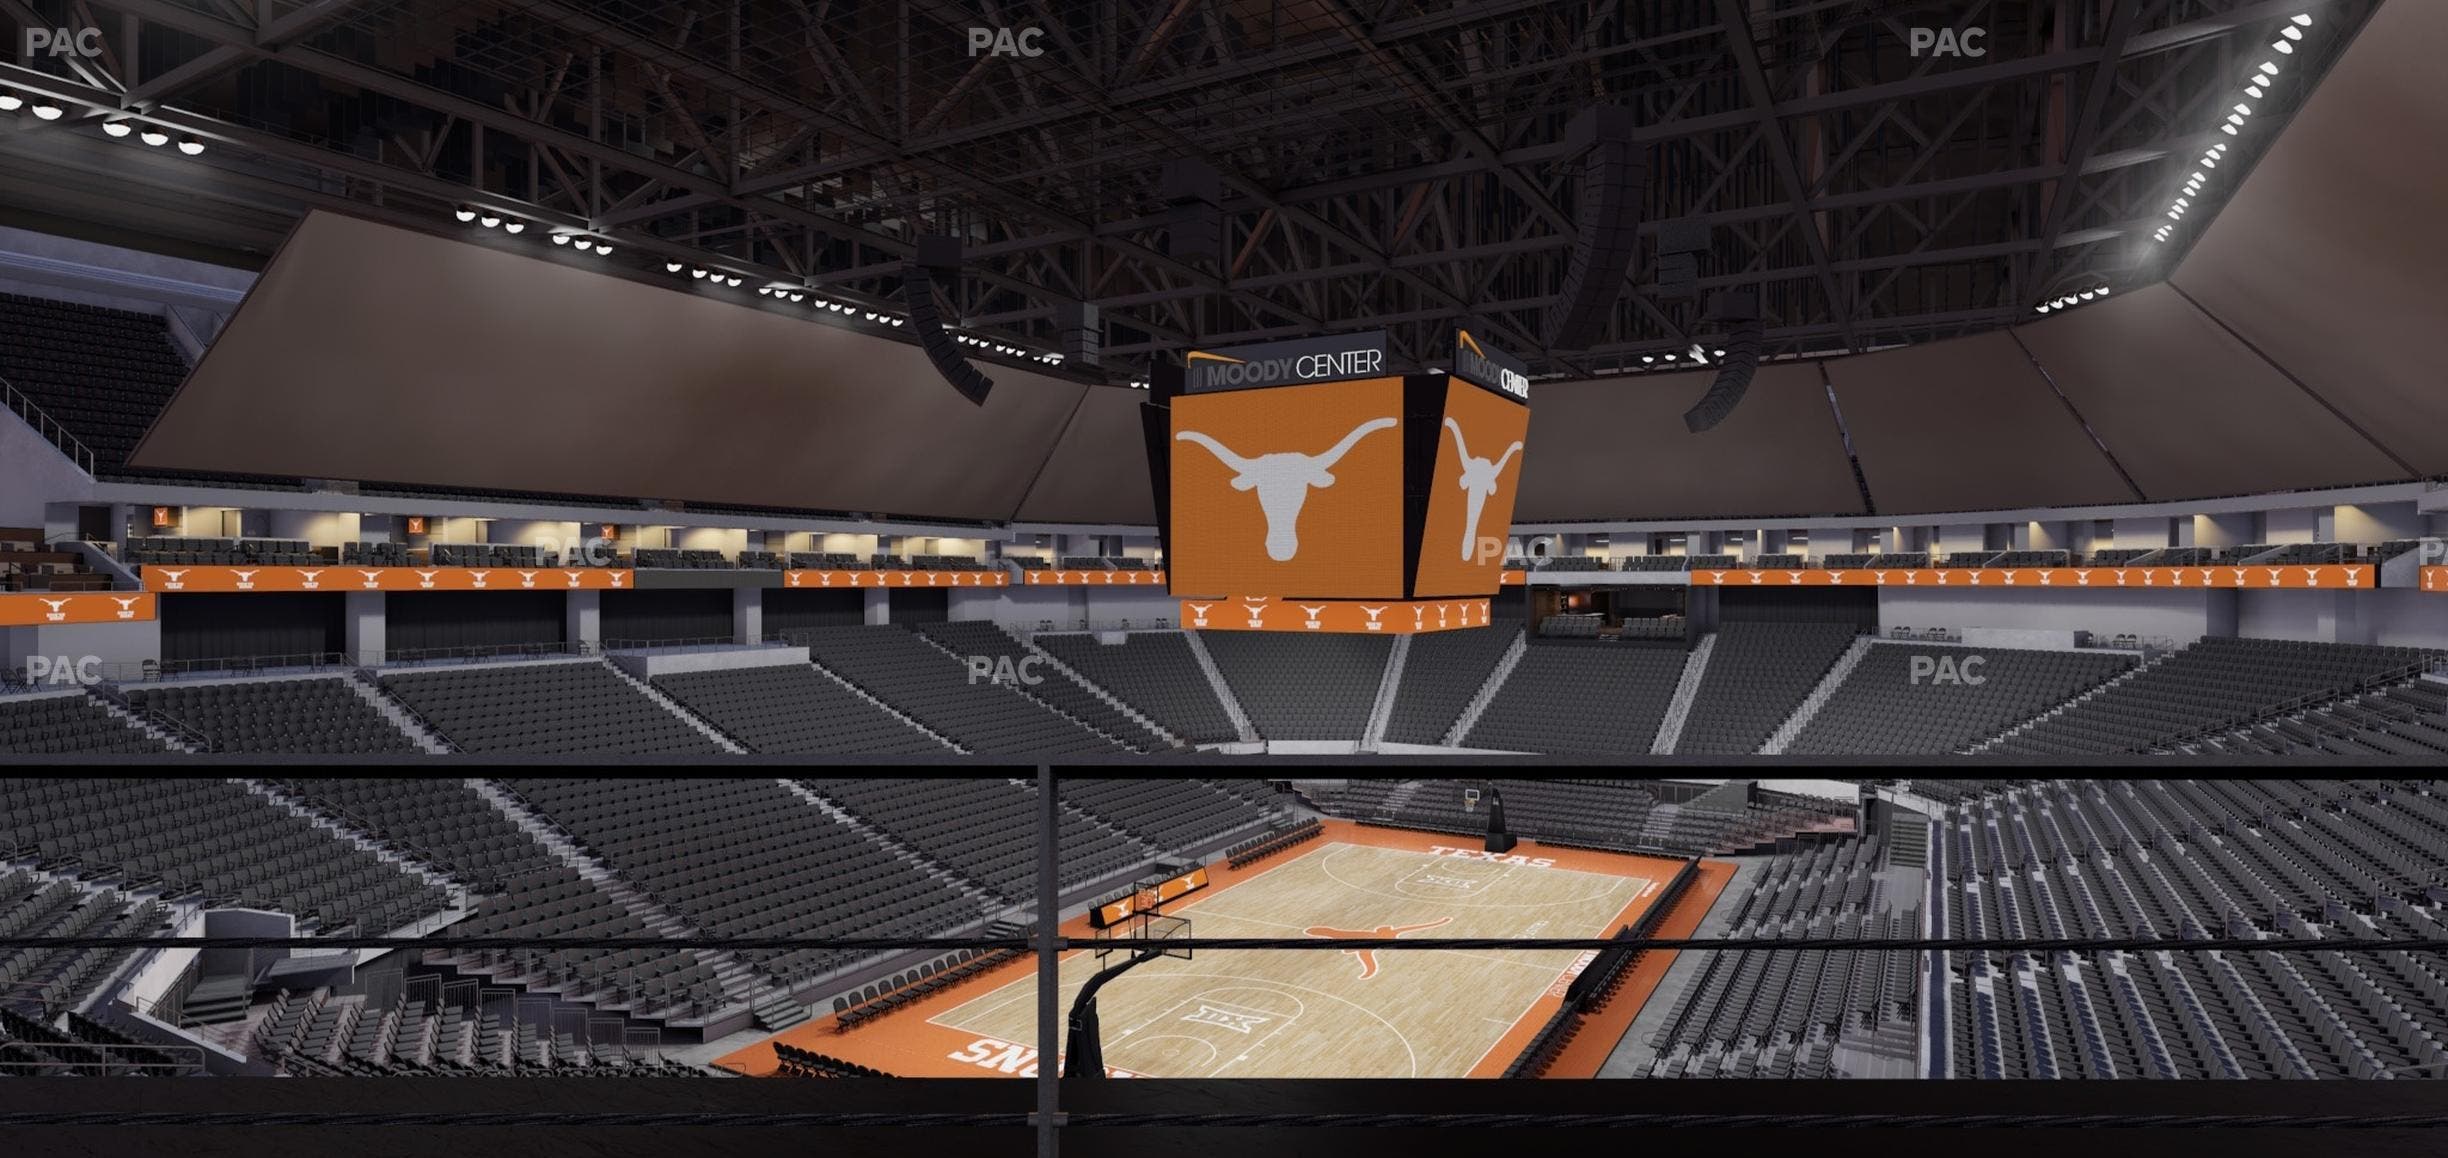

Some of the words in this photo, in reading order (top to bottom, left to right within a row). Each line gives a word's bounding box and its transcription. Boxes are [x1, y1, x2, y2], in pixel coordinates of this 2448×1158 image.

[1207, 357, 1295, 387] MOODY
[1296, 348, 1383, 379] CENTER
[1427, 845, 1557, 868] TEXAS
